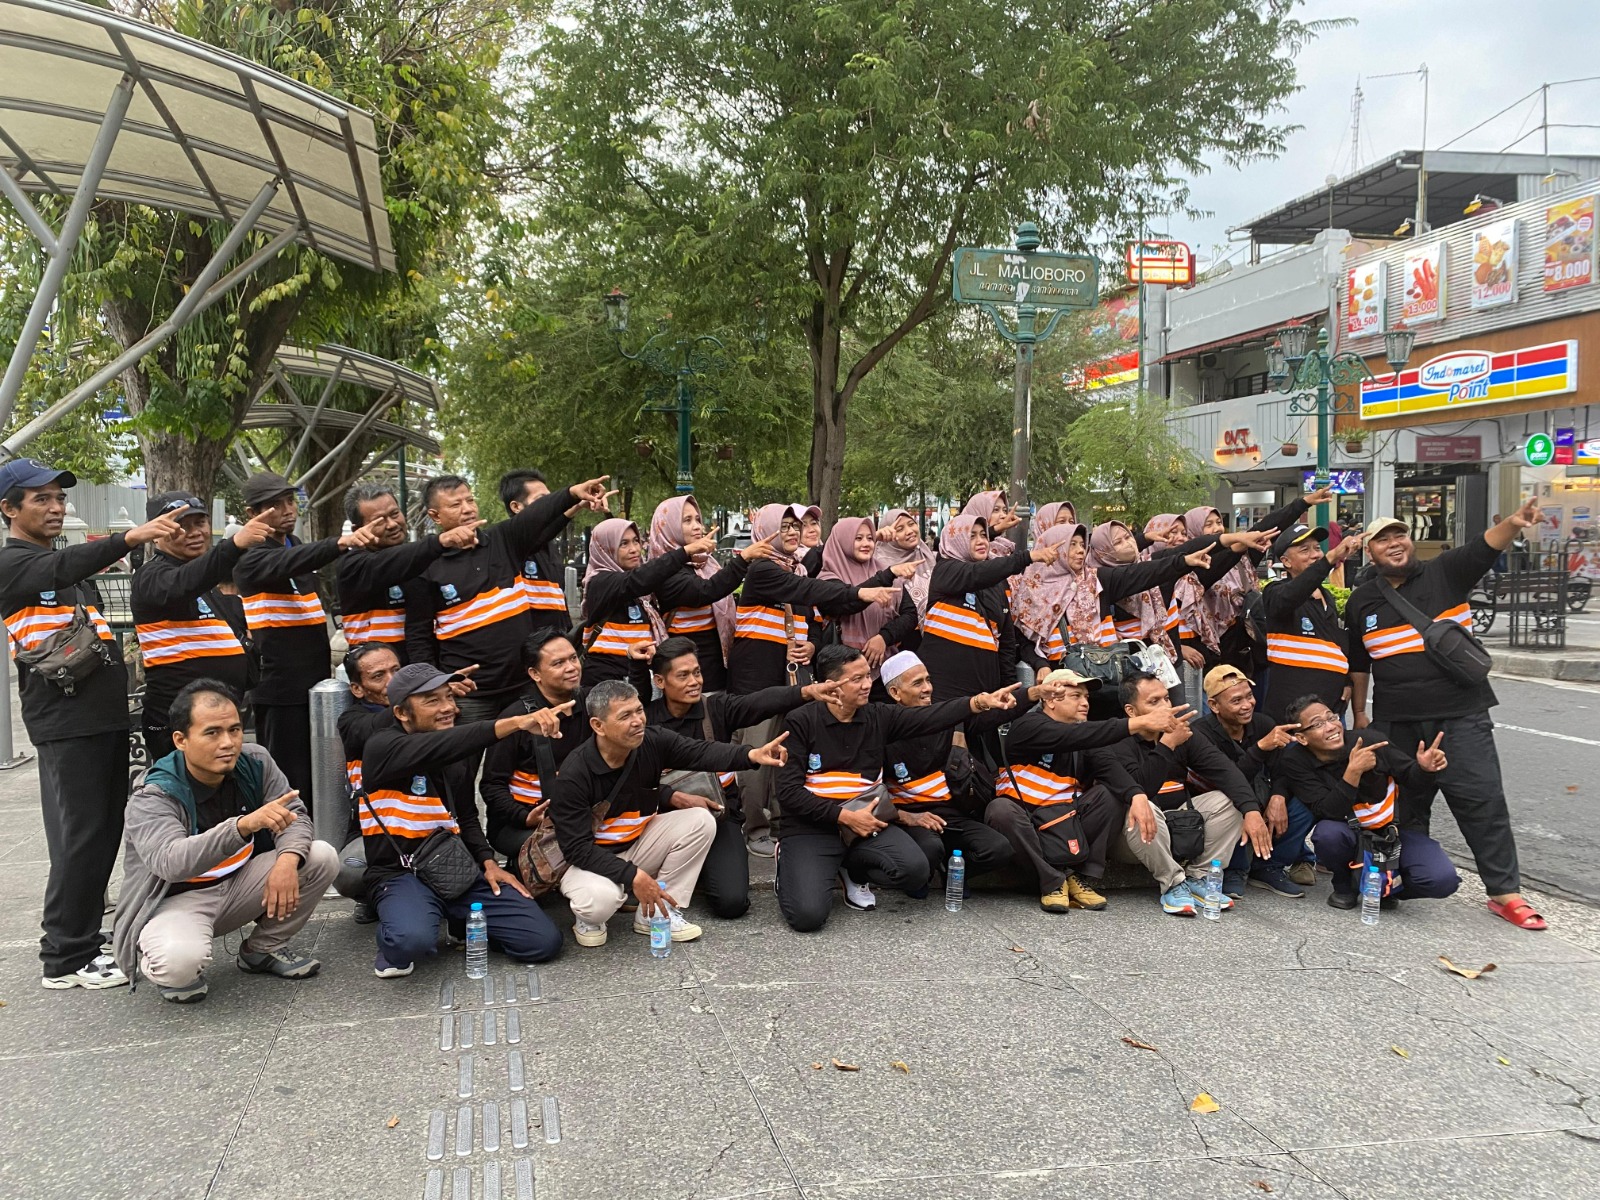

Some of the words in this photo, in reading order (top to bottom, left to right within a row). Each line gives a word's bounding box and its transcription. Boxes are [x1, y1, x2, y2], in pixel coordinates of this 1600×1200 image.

[970, 262, 988, 276] JL.
[998, 264, 1086, 283] MALIOBORO
[1408, 300, 1437, 314] 13.000
[1424, 360, 1485, 381] Indomaret
[1449, 379, 1489, 401] Point
